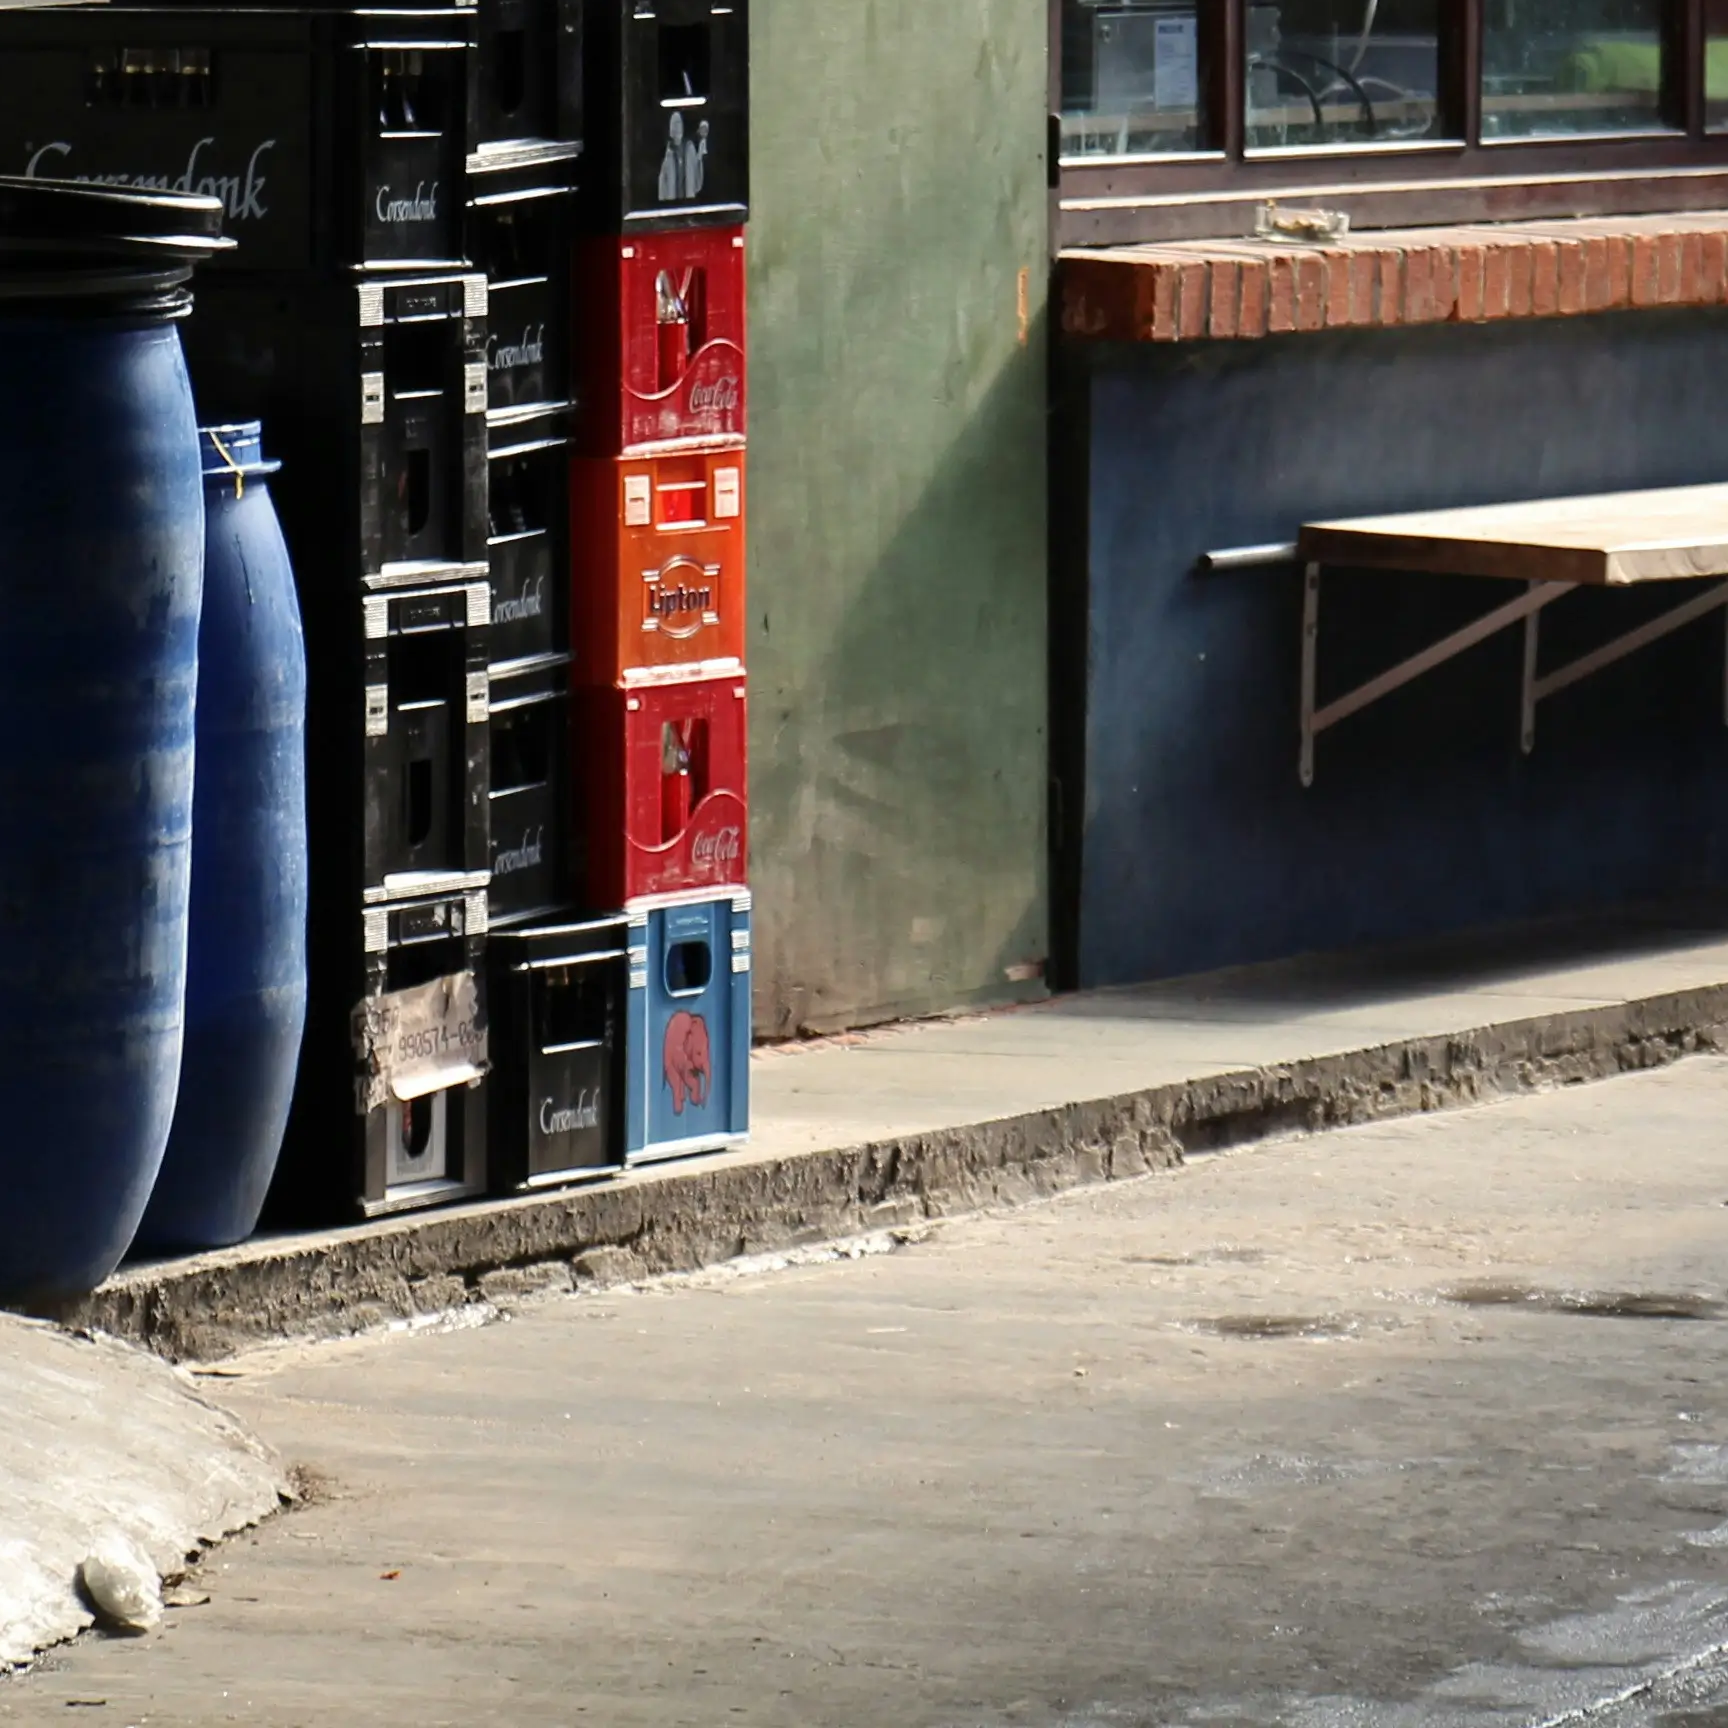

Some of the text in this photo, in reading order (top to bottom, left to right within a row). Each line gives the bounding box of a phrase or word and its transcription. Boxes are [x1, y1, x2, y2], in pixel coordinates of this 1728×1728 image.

[491, 575, 544, 625] orsendonk
[649, 583, 710, 620] Lipton
[491, 824, 544, 875] orsendonk
